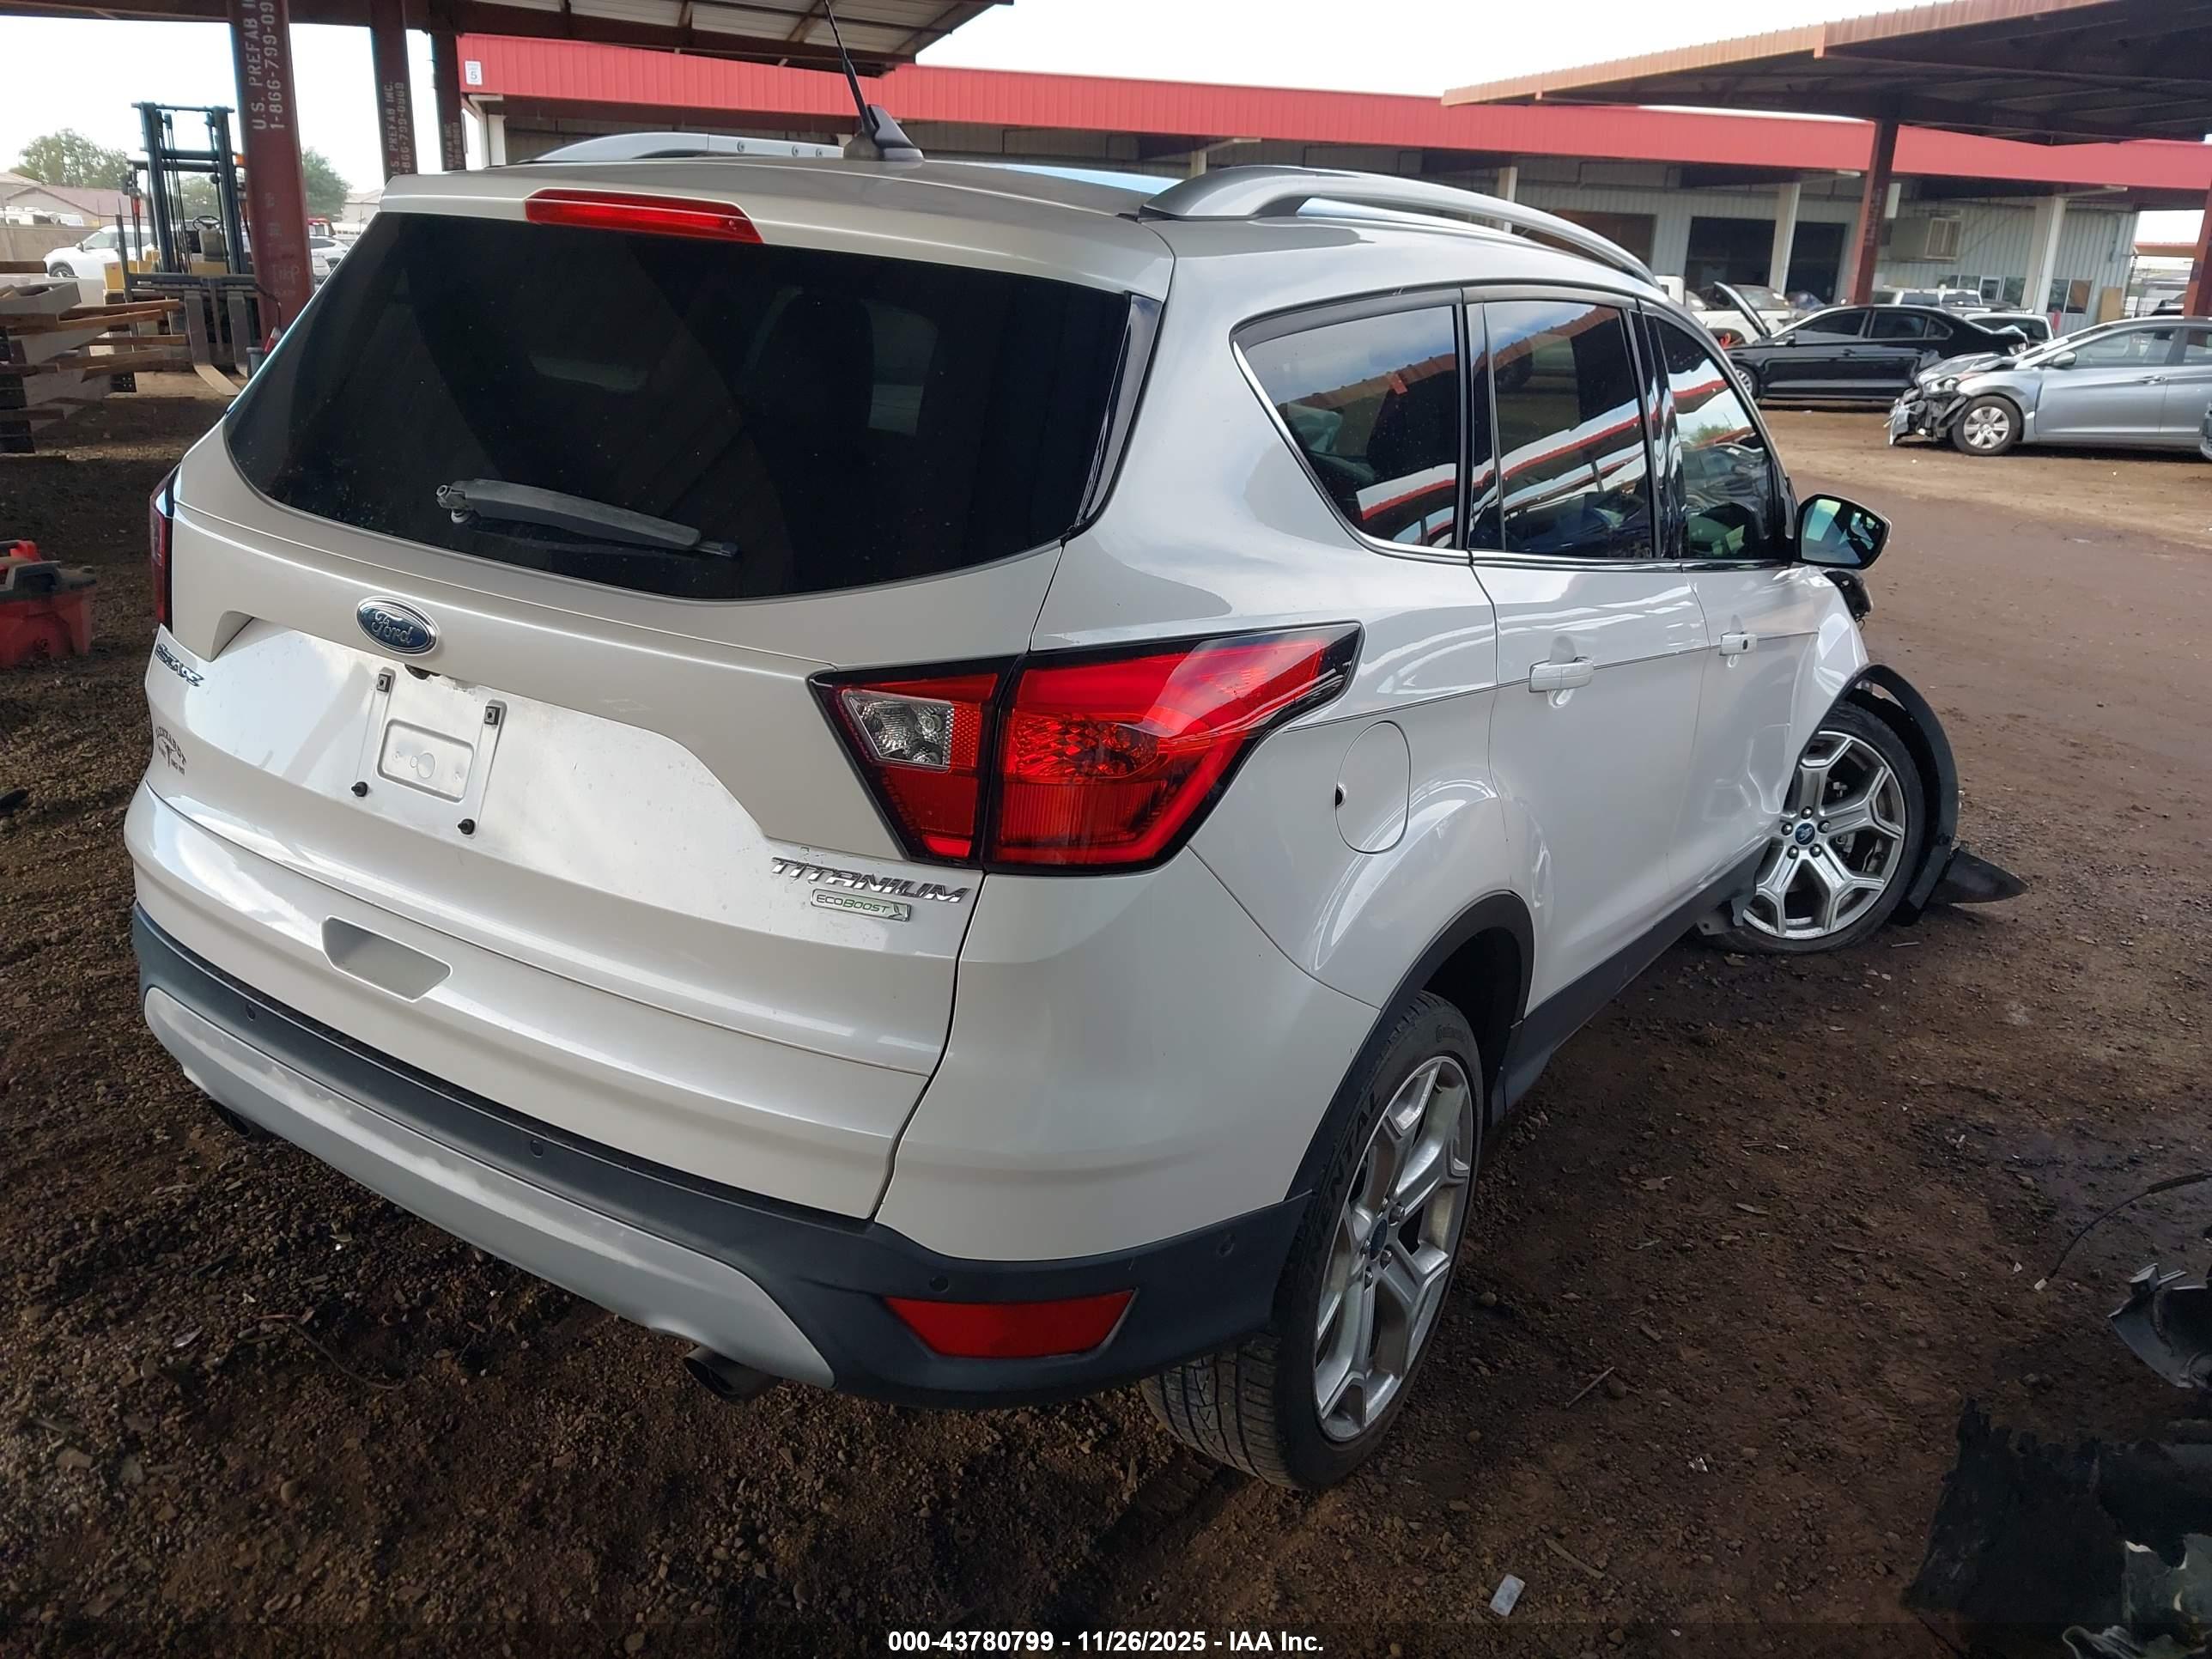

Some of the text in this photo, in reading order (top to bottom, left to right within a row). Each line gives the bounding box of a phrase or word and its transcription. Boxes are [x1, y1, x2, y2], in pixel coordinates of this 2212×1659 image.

[243, 17, 264, 87] PREFAB
[259, 0, 285, 130] 1-866-799-09
[251, 97, 267, 130] U.S.
[371, 611, 414, 646] Ford
[771, 857, 970, 903] TITANIUM
